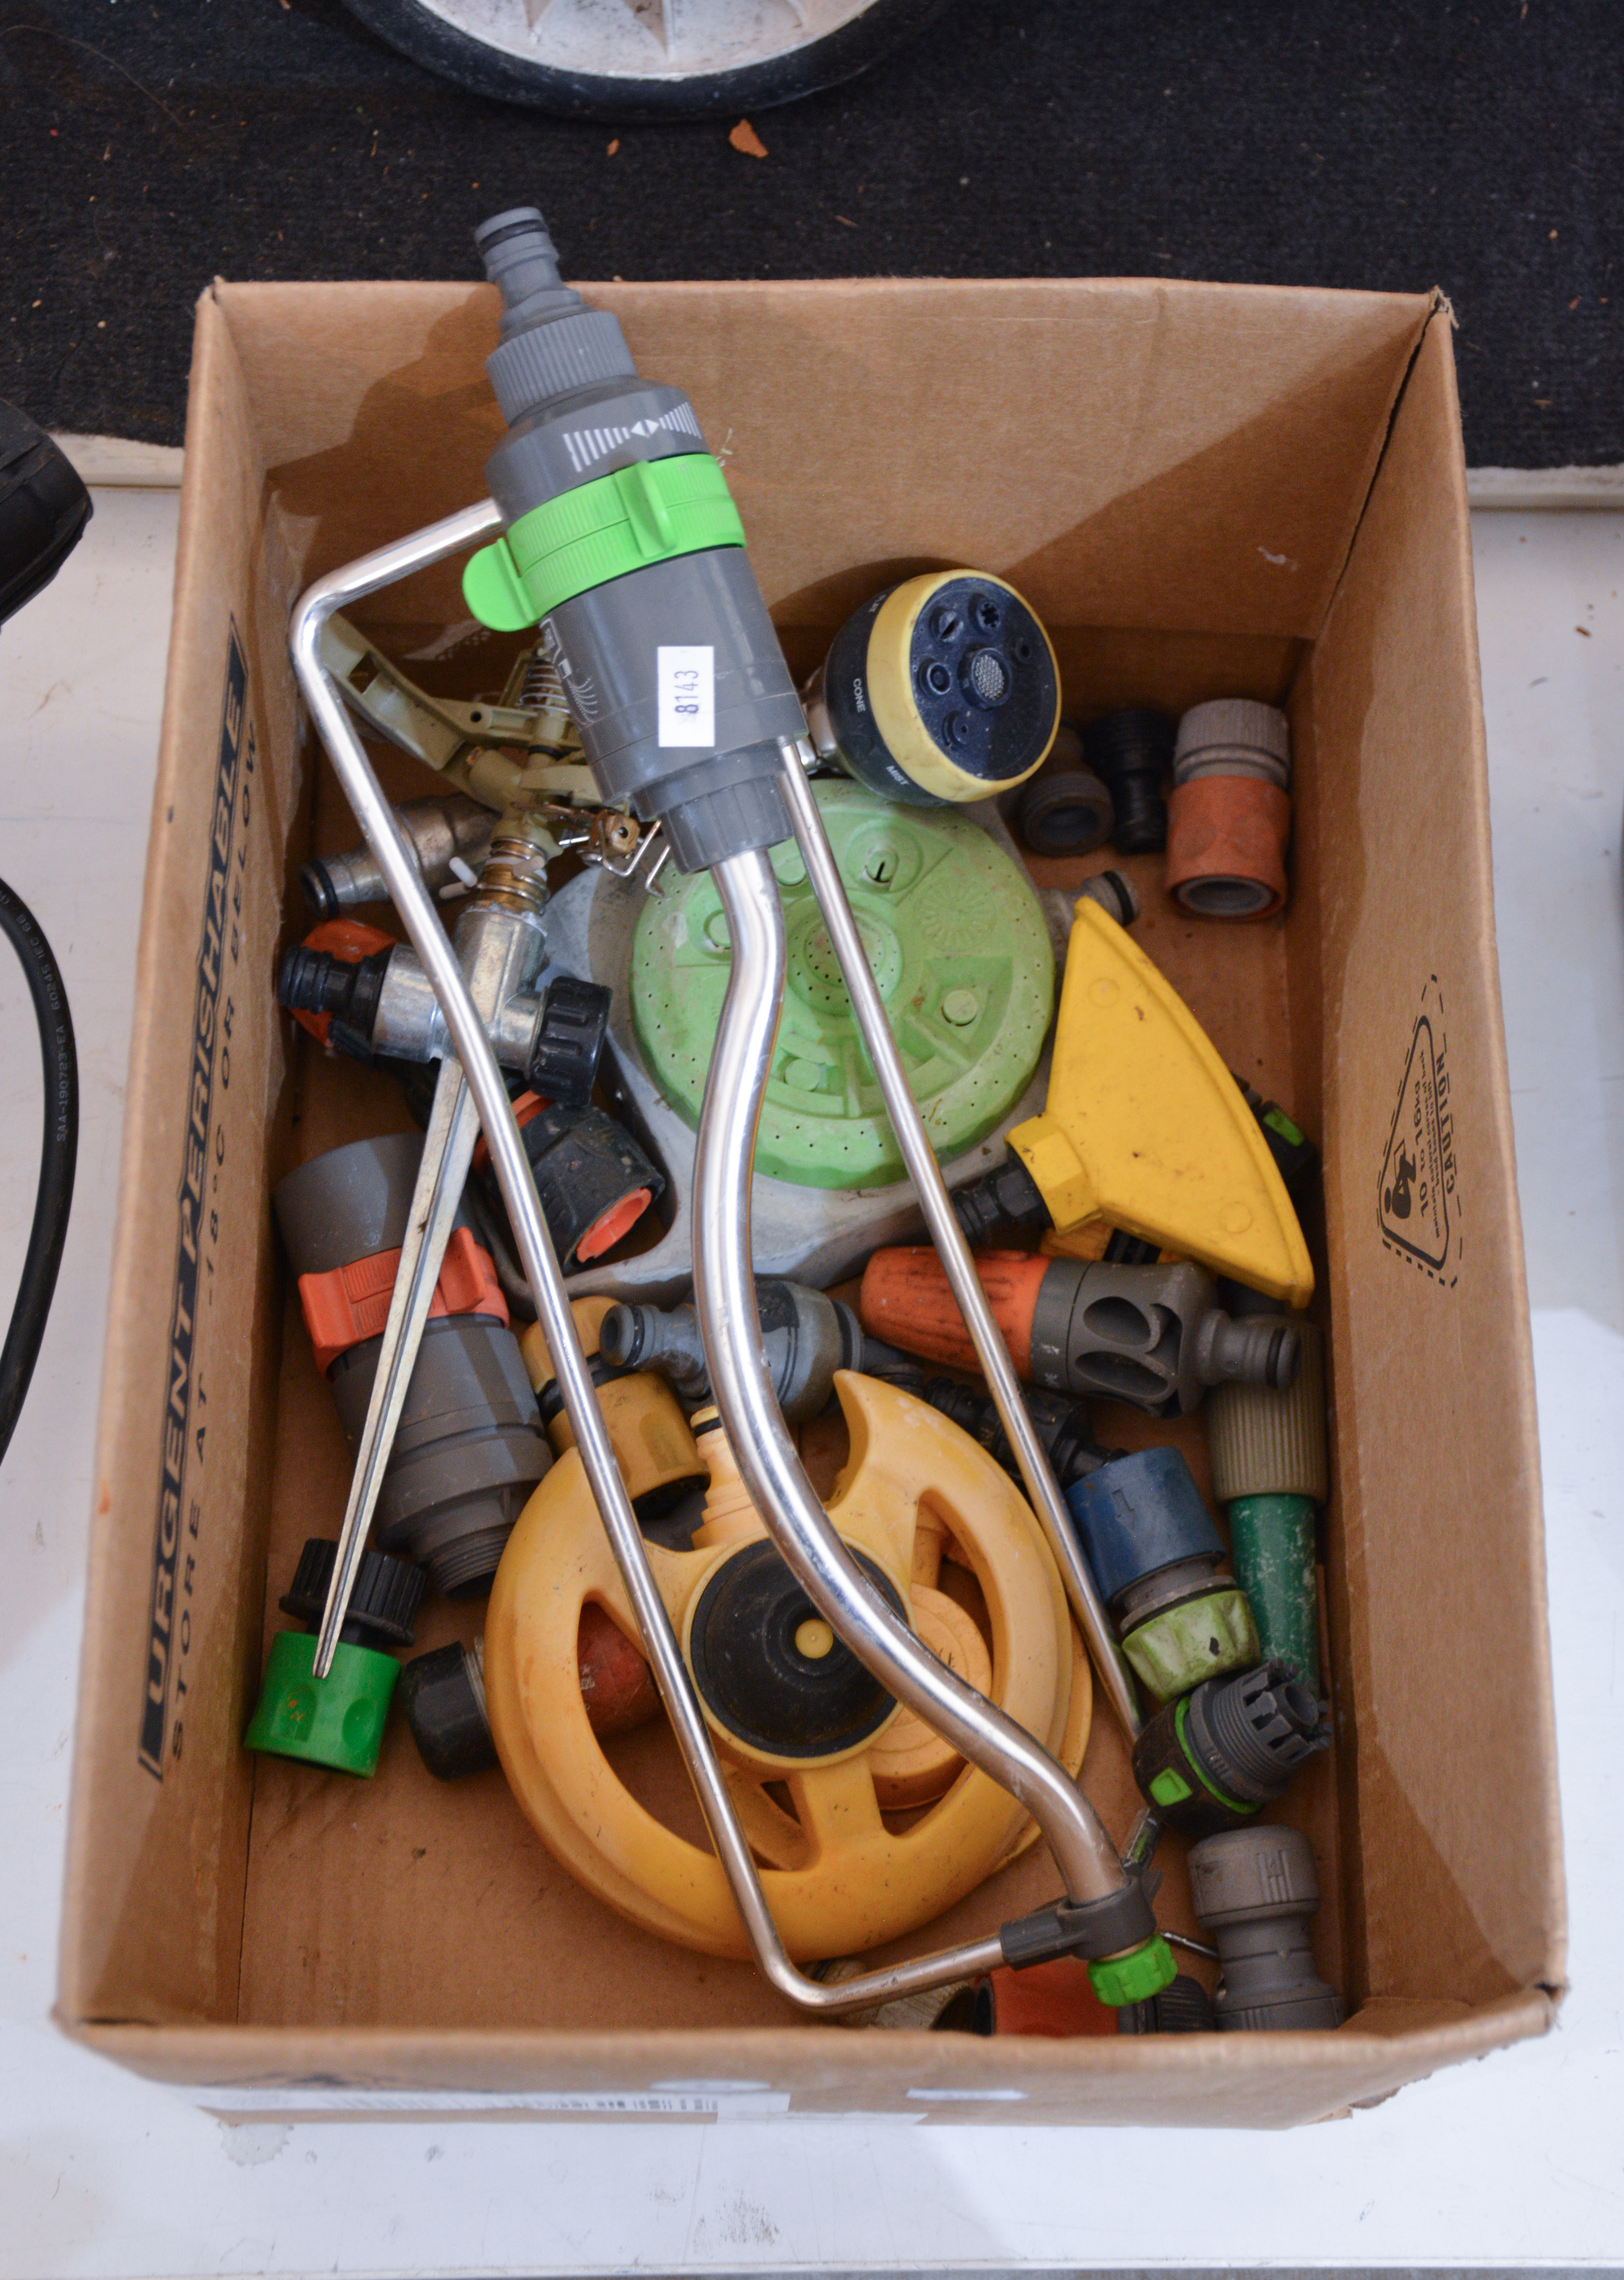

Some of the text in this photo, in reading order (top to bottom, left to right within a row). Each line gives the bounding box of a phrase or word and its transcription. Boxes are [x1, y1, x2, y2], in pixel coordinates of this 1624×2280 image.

[674, 671, 699, 714] 8143
[853, 678, 866, 713] CONE
[886, 765, 910, 785] MIST
[30, 936, 45, 959] IEC
[42, 964, 60, 1010] 60245
[1422, 1081, 1427, 1093] of
[1436, 1052, 1455, 1194] CAUTION
[1414, 1080, 1429, 1218] 10 to 16kg
[148, 680, 241, 1705] URGENT PERISHABLE
[172, 1499, 200, 1761] STORE
[196, 1371, 206, 1466] AT
[221, 995, 234, 1091] OR
[231, 719, 256, 967] BELOW
